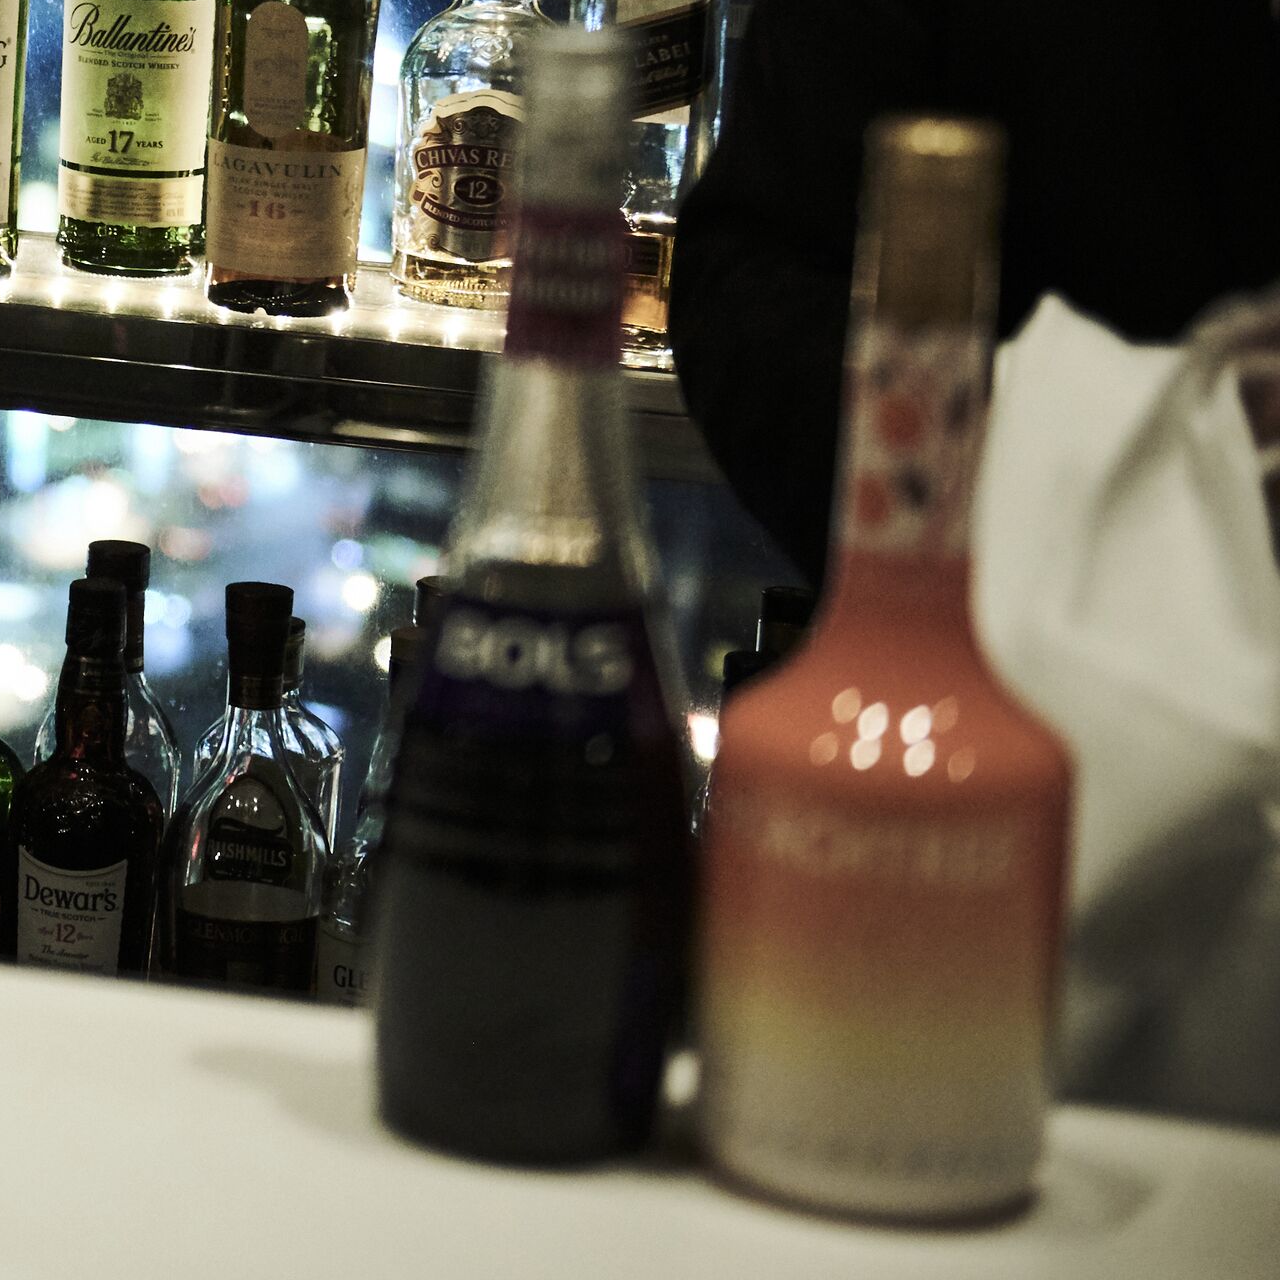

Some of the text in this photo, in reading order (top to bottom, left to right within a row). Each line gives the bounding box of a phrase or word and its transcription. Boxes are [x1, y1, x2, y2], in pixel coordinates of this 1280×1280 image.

[70, 2, 197, 53] Ballantine's
[111, 60, 146, 70] SCOTCH
[147, 62, 180, 70] WHISKY
[85, 129, 164, 154] AGED 17 YEARS
[214, 152, 343, 179] LAGAVULIN
[416, 148, 481, 168] CHIVAS
[468, 180, 489, 200] 12
[249, 200, 287, 220] 16
[422, 201, 460, 224] BLENDED
[206, 838, 288, 868] BUSHMILLS
[24, 873, 119, 912] Dewar's
[40, 907, 96, 923] TRUE SCOTCH
[55, 922, 77, 945] 12
